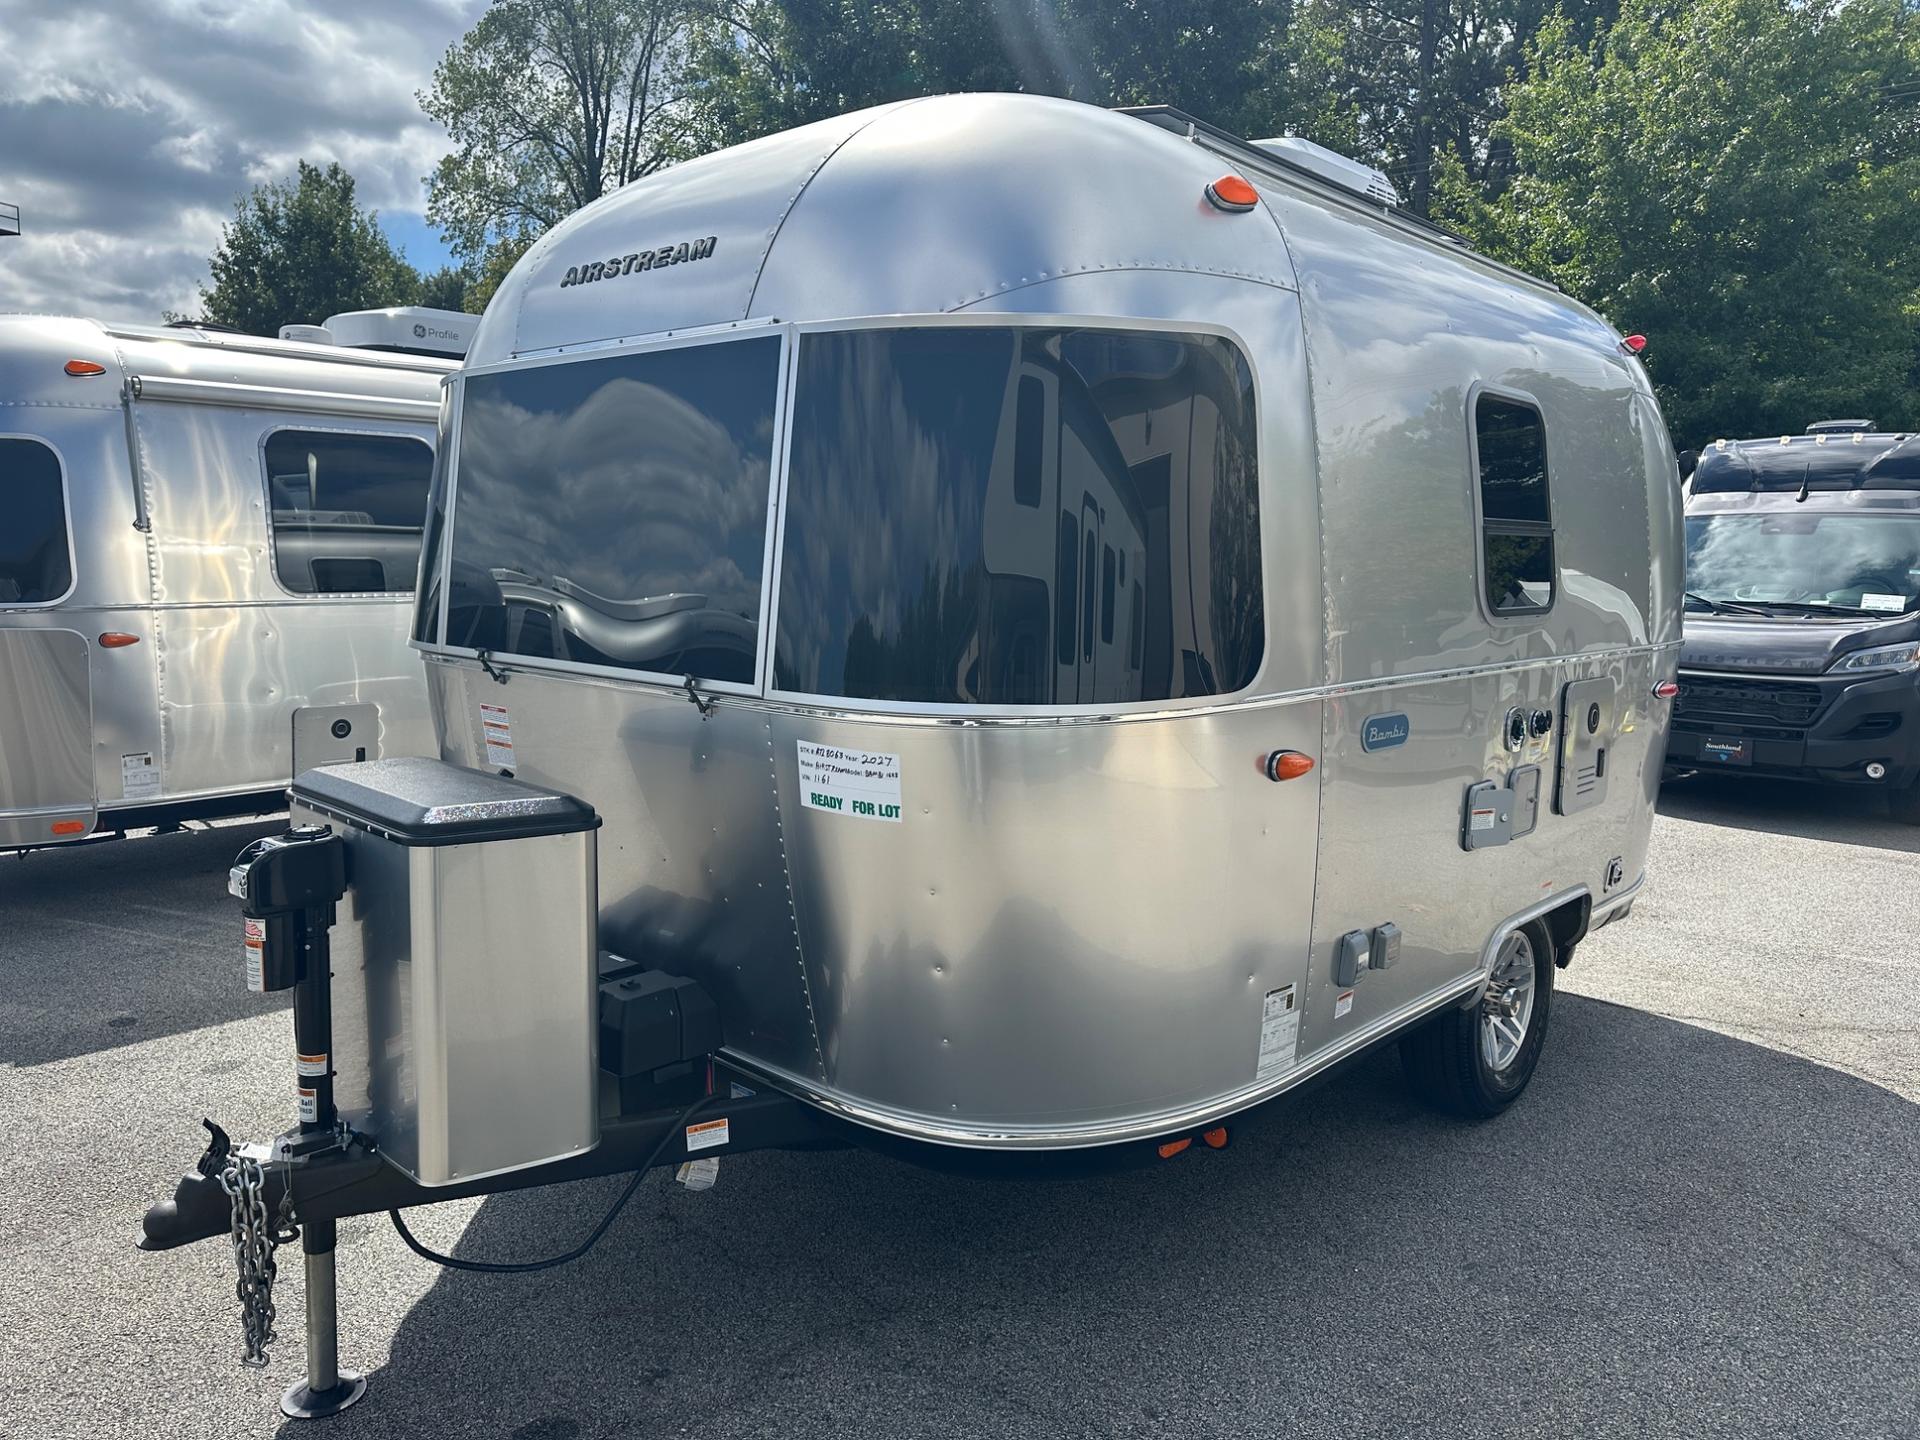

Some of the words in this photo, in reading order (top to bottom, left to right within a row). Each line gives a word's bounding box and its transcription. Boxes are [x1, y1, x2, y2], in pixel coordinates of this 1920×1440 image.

[560, 236, 718, 288] AIRSTREAM
[428, 327, 460, 341] Profile
[1686, 654, 1815, 669] IRSTREAM
[1368, 724, 1406, 742] Bambi
[862, 754, 893, 767] 2027
[810, 792, 844, 810] READY
[852, 800, 875, 815] FOR
[878, 804, 901, 818] LOT
